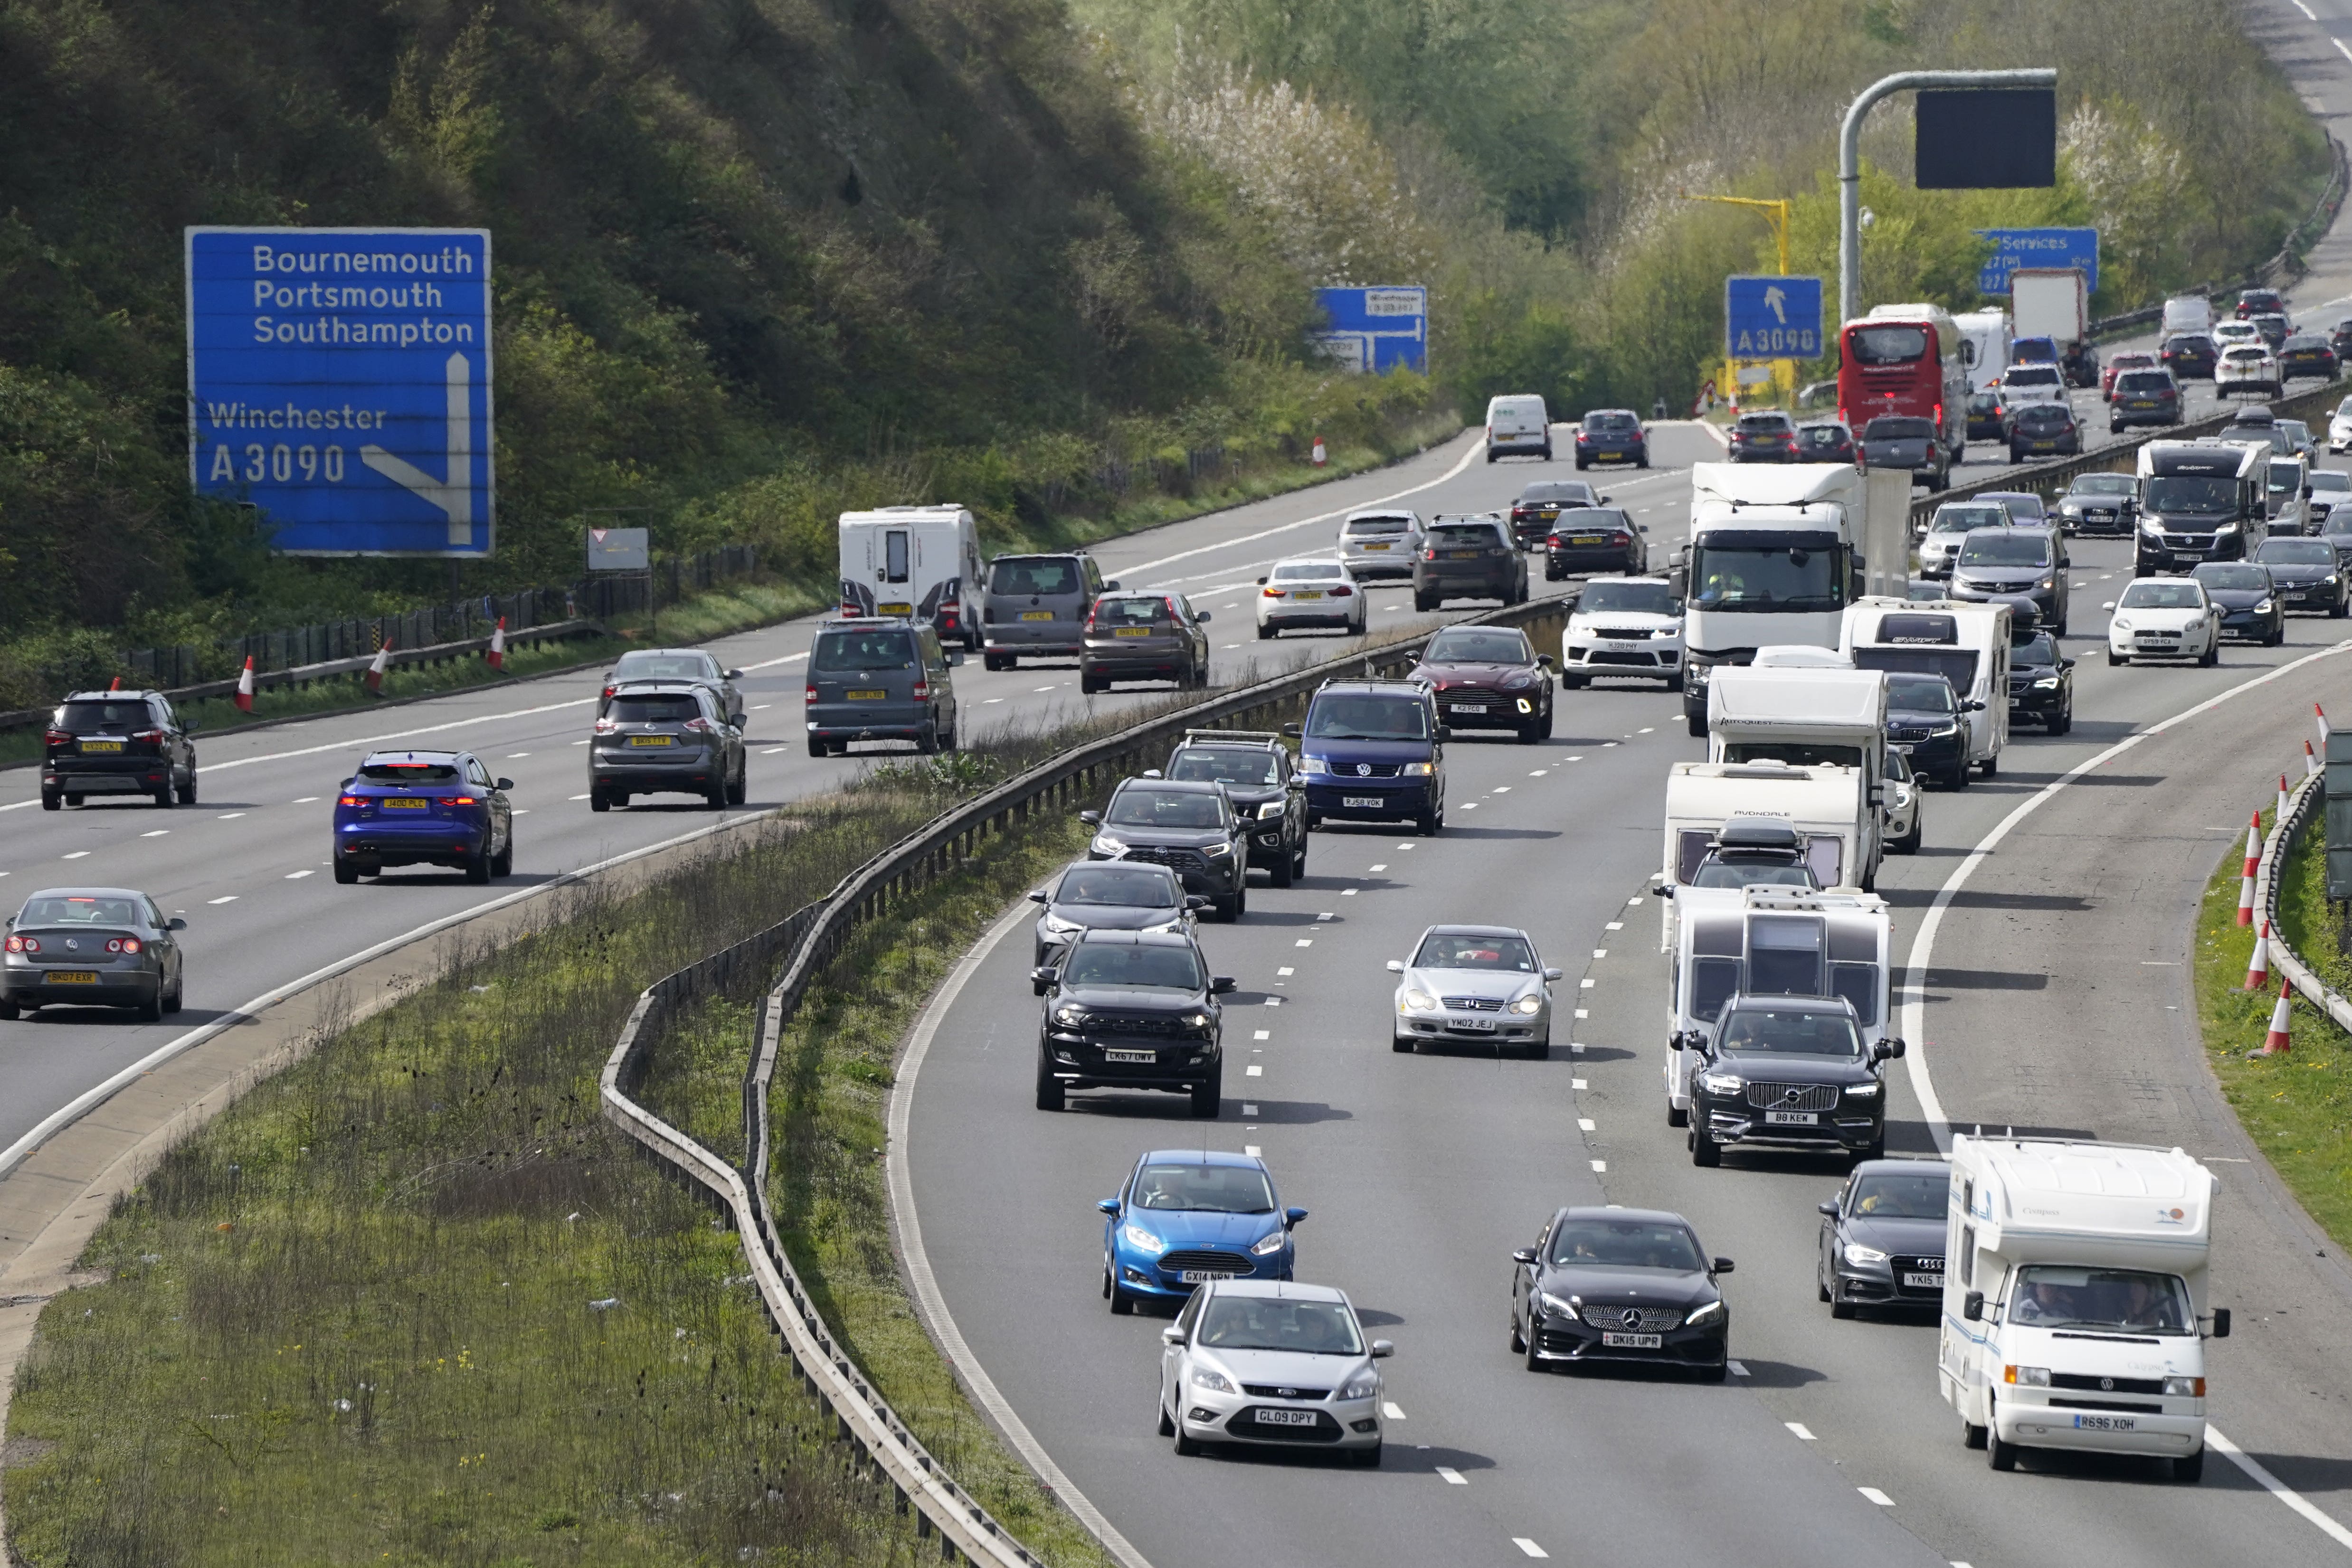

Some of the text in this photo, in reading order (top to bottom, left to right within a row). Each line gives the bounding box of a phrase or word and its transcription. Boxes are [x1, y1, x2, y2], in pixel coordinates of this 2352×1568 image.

[2002, 236, 2067, 250] Services
[253, 245, 474, 274] Bournemouth
[254, 280, 443, 308] Portsmouth
[254, 316, 473, 348] Southampton
[1737, 328, 1814, 351] A3090
[209, 402, 387, 429] Winchester
[52, 973, 92, 982] BK07 EXR
[1451, 1019, 1492, 1029] YM02 JEJ
[1775, 1113, 1788, 1122] B8
[2022, 1208, 2059, 1216] Compass
[1186, 1272, 1207, 1281] GX14
[1911, 1275, 1933, 1285] YK15
[1613, 1335, 1658, 1346] DK15 UPR
[2127, 1361, 2163, 1372] Calypso
[1260, 1411, 1312, 1424] GL09 OPY
[2081, 1417, 2134, 1429] R696 XOH
